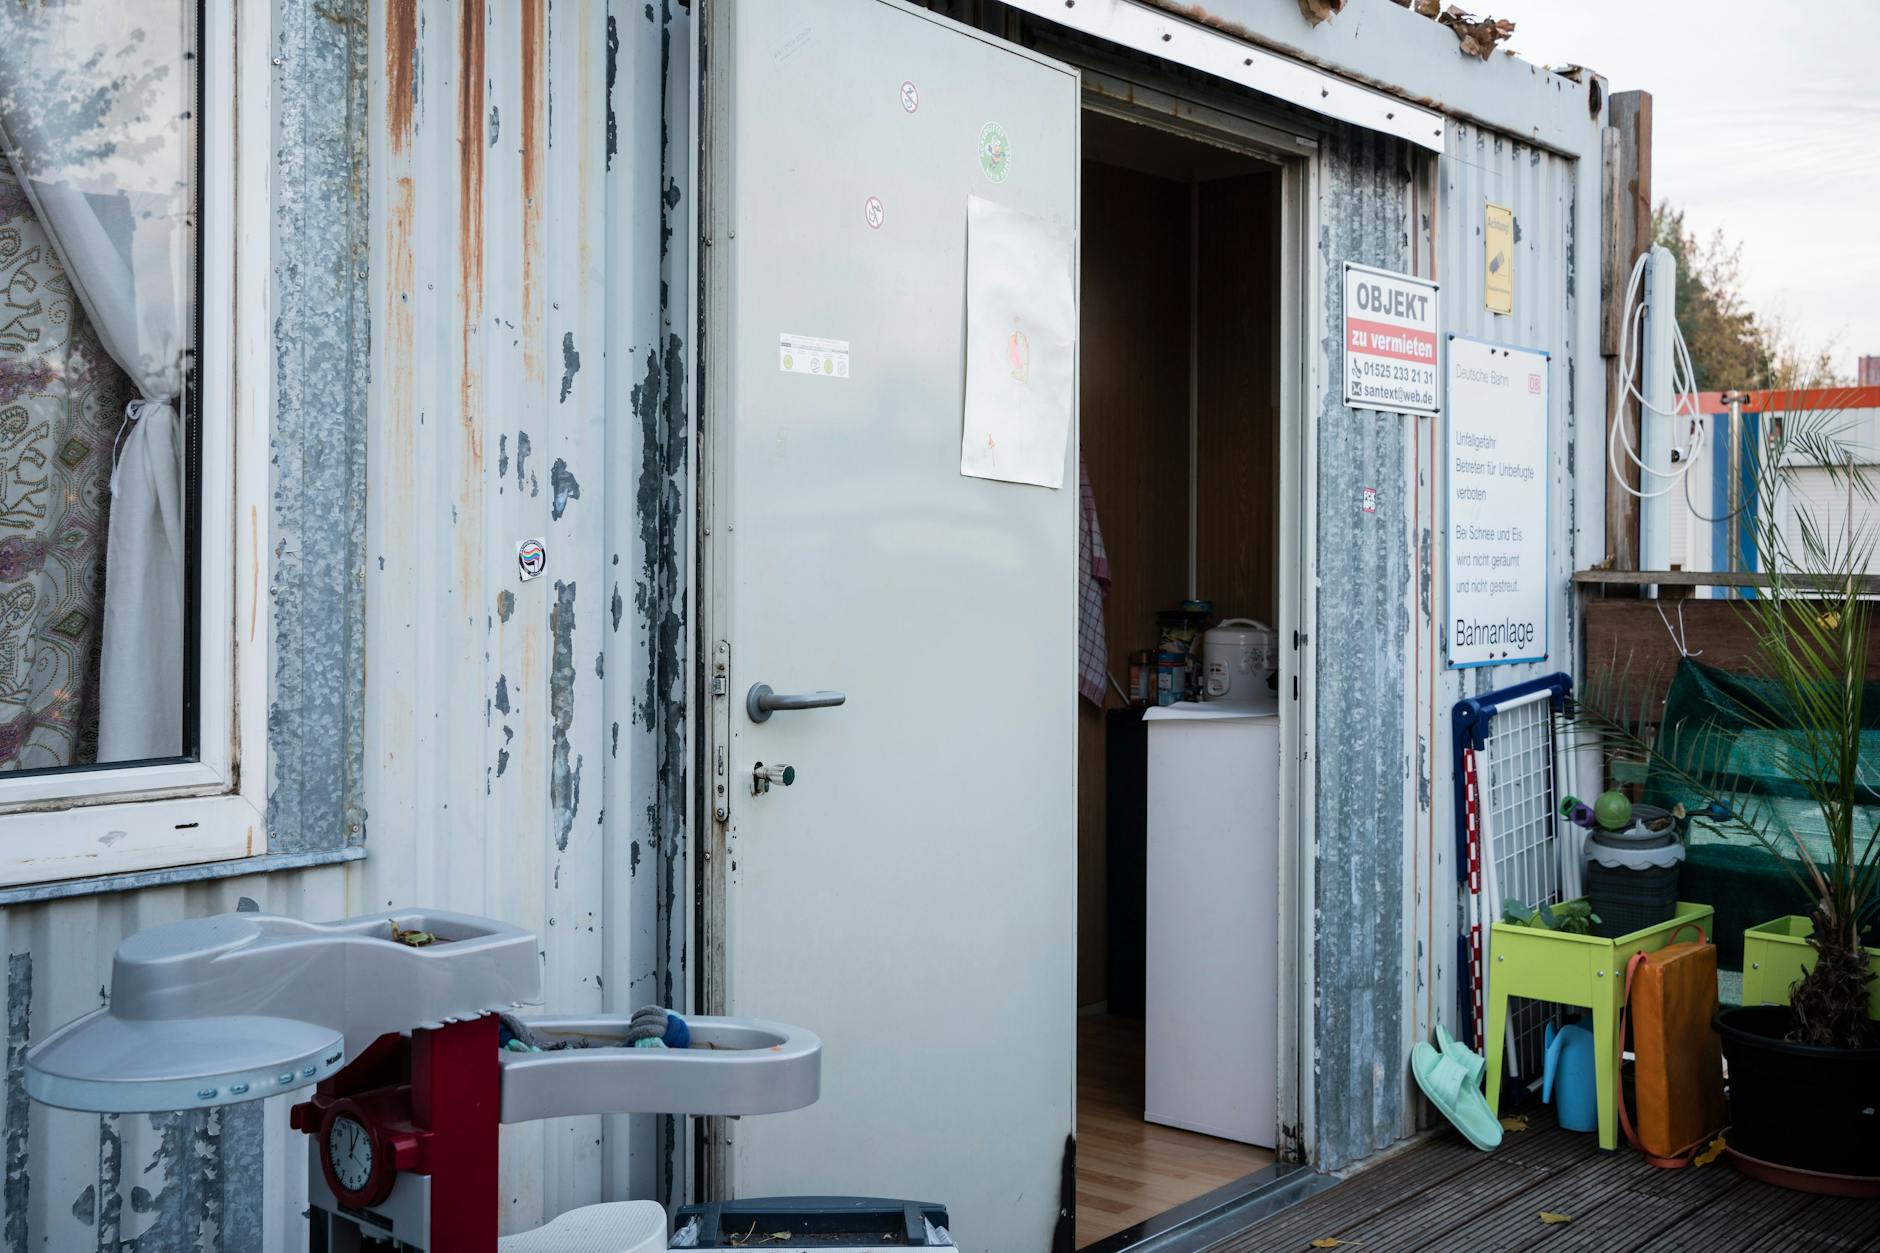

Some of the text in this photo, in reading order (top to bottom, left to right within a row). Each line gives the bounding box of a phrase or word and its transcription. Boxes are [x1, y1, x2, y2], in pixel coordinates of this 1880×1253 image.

[1357, 282, 1428, 322] OBJEKT
[1352, 329, 1433, 358] zu vermieten
[1363, 361, 1433, 386] 01525 233 21 31
[1456, 363, 1510, 388] Deutsche Bahn
[1529, 375, 1540, 392] DB
[1364, 385, 1433, 405] santext@web.de
[1456, 431, 1496, 451] Unfallgefahr
[1456, 457, 1535, 482] Betreten für Unbefugte
[1456, 484, 1487, 501] verboten
[1456, 524, 1523, 542] Bei Schnee und Eis
[1456, 551, 1520, 570] wird nicht geräumt
[1456, 578, 1469, 593] und
[1471, 577, 1487, 593] nicht
[1456, 617, 1534, 650] Bahnanlage
